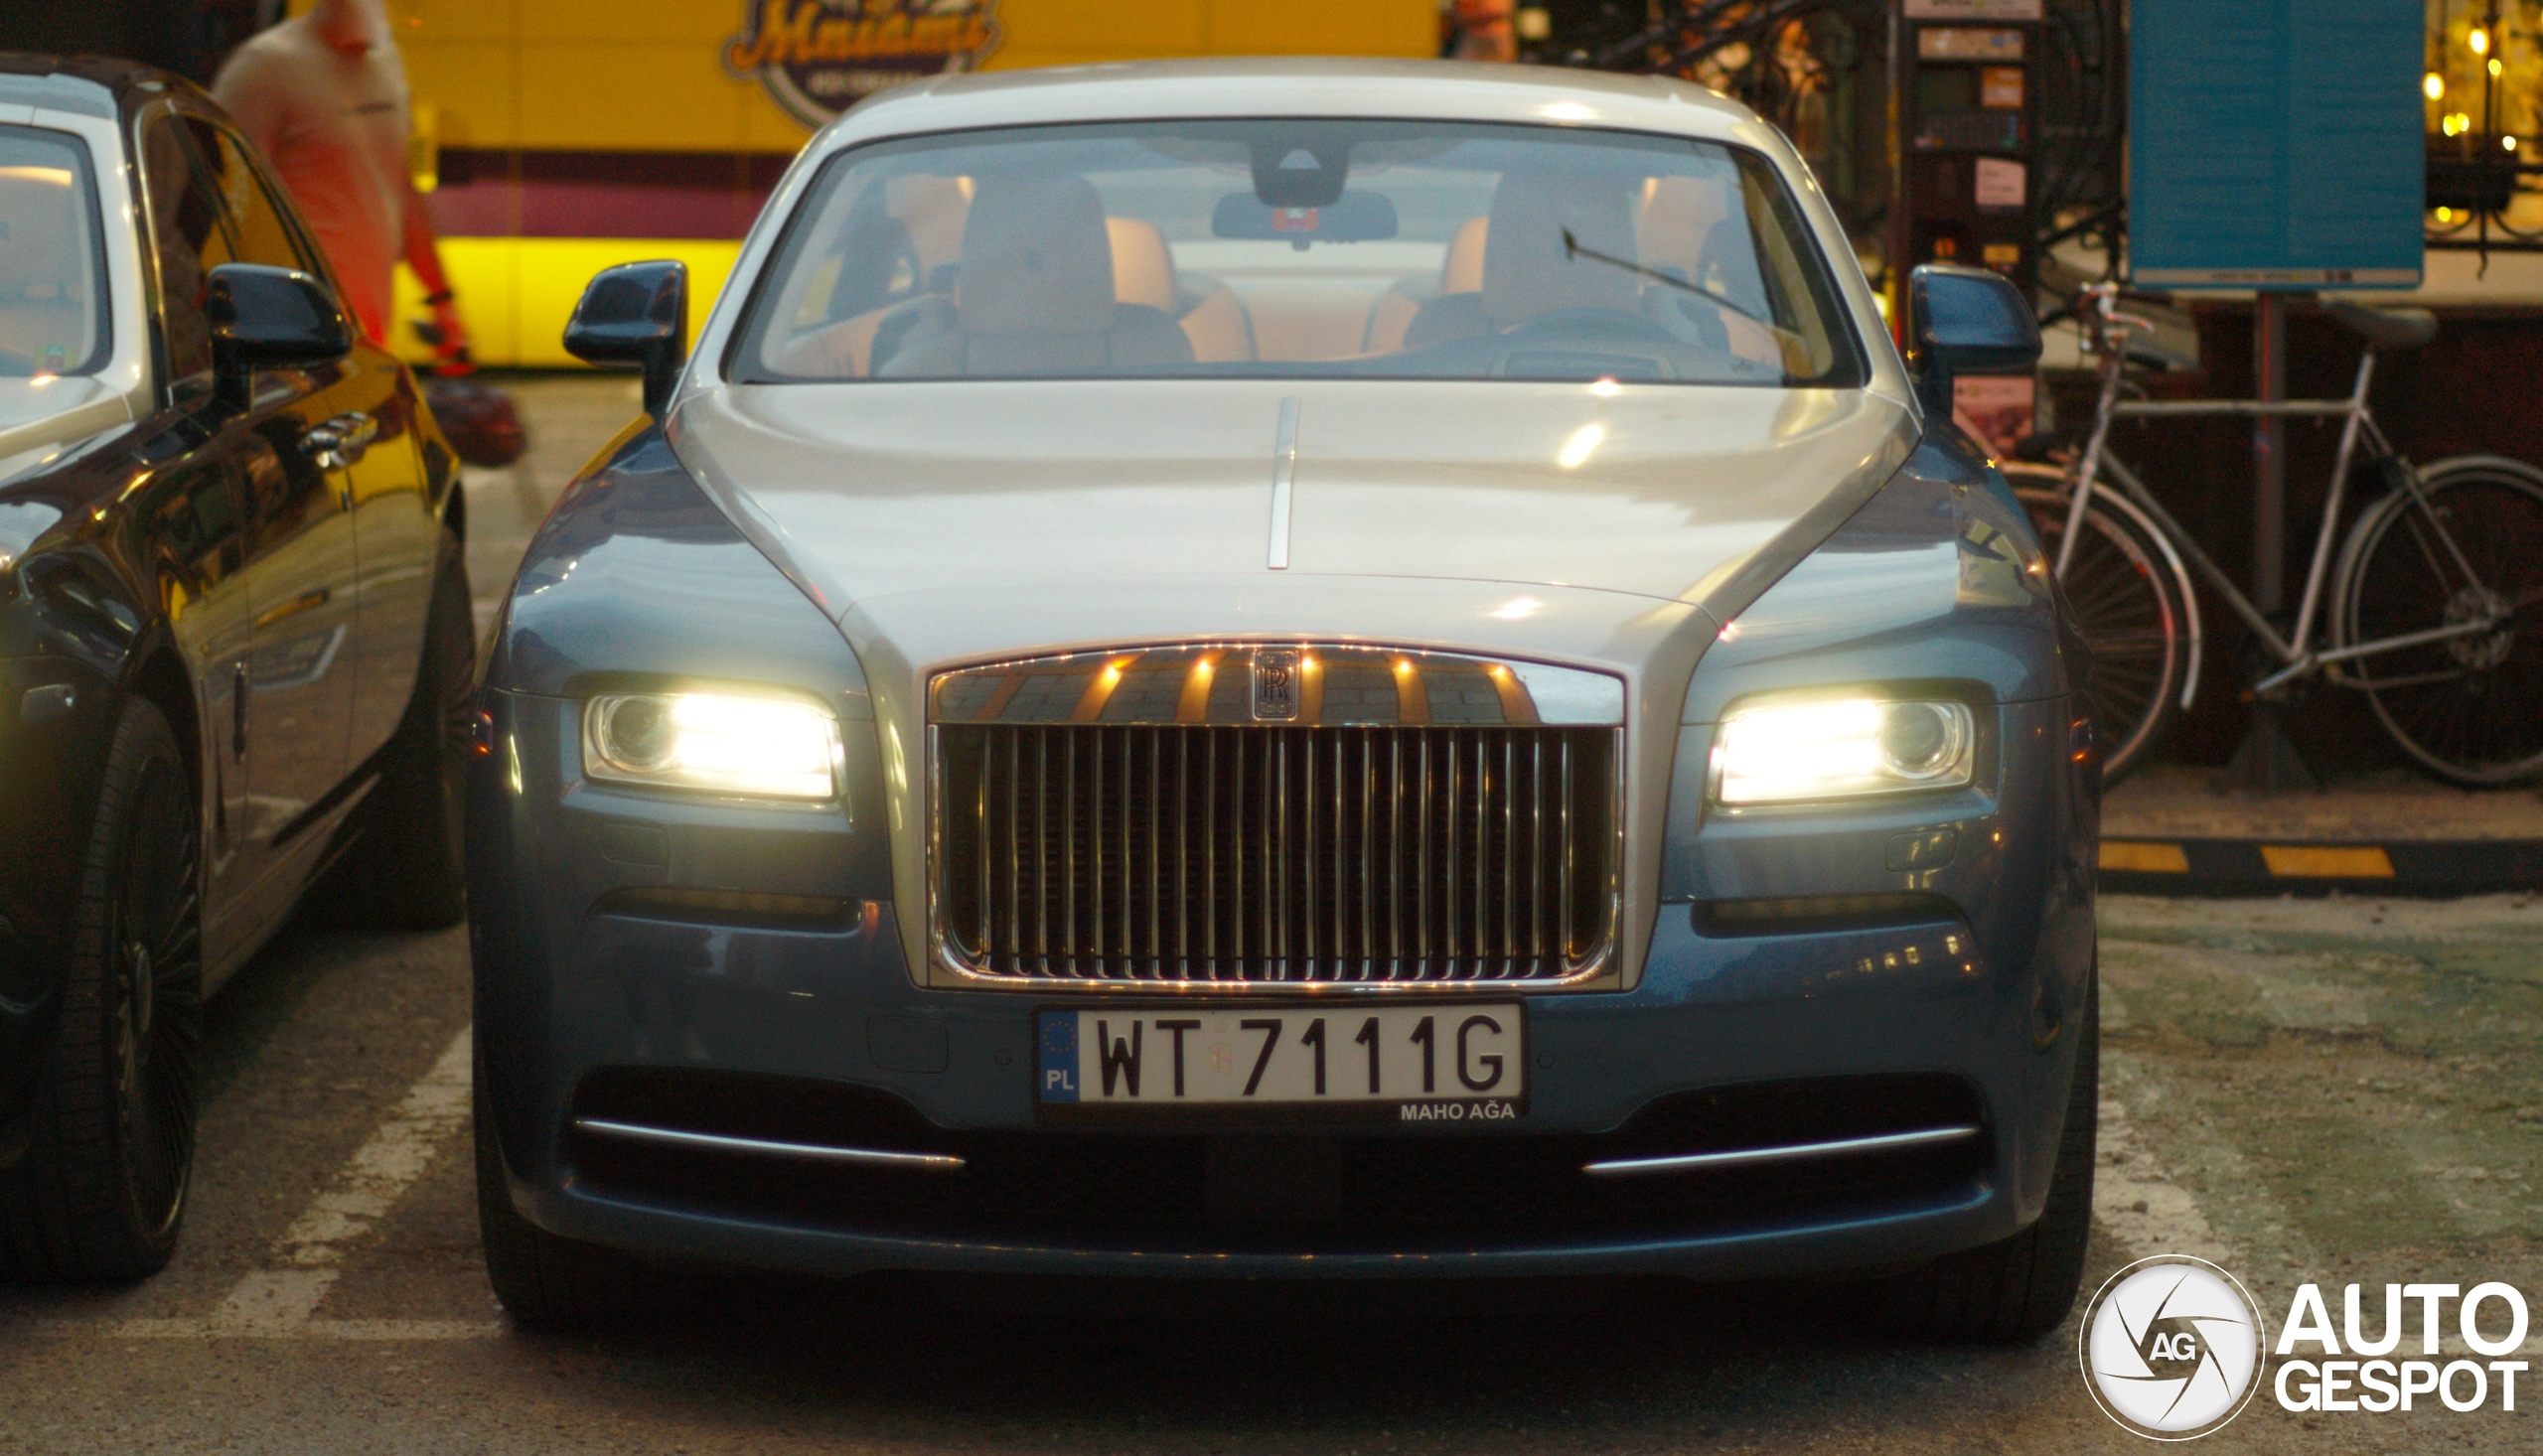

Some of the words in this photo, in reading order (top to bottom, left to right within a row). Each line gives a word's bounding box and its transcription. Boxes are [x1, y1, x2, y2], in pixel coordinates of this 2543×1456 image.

[1097, 1019, 1202, 1097] WT
[1240, 1014, 1503, 1096] 7111G
[1047, 1070, 1075, 1091] PL
[1401, 1103, 1464, 1120] MAHO
[1468, 1099, 1516, 1119] AĞA
